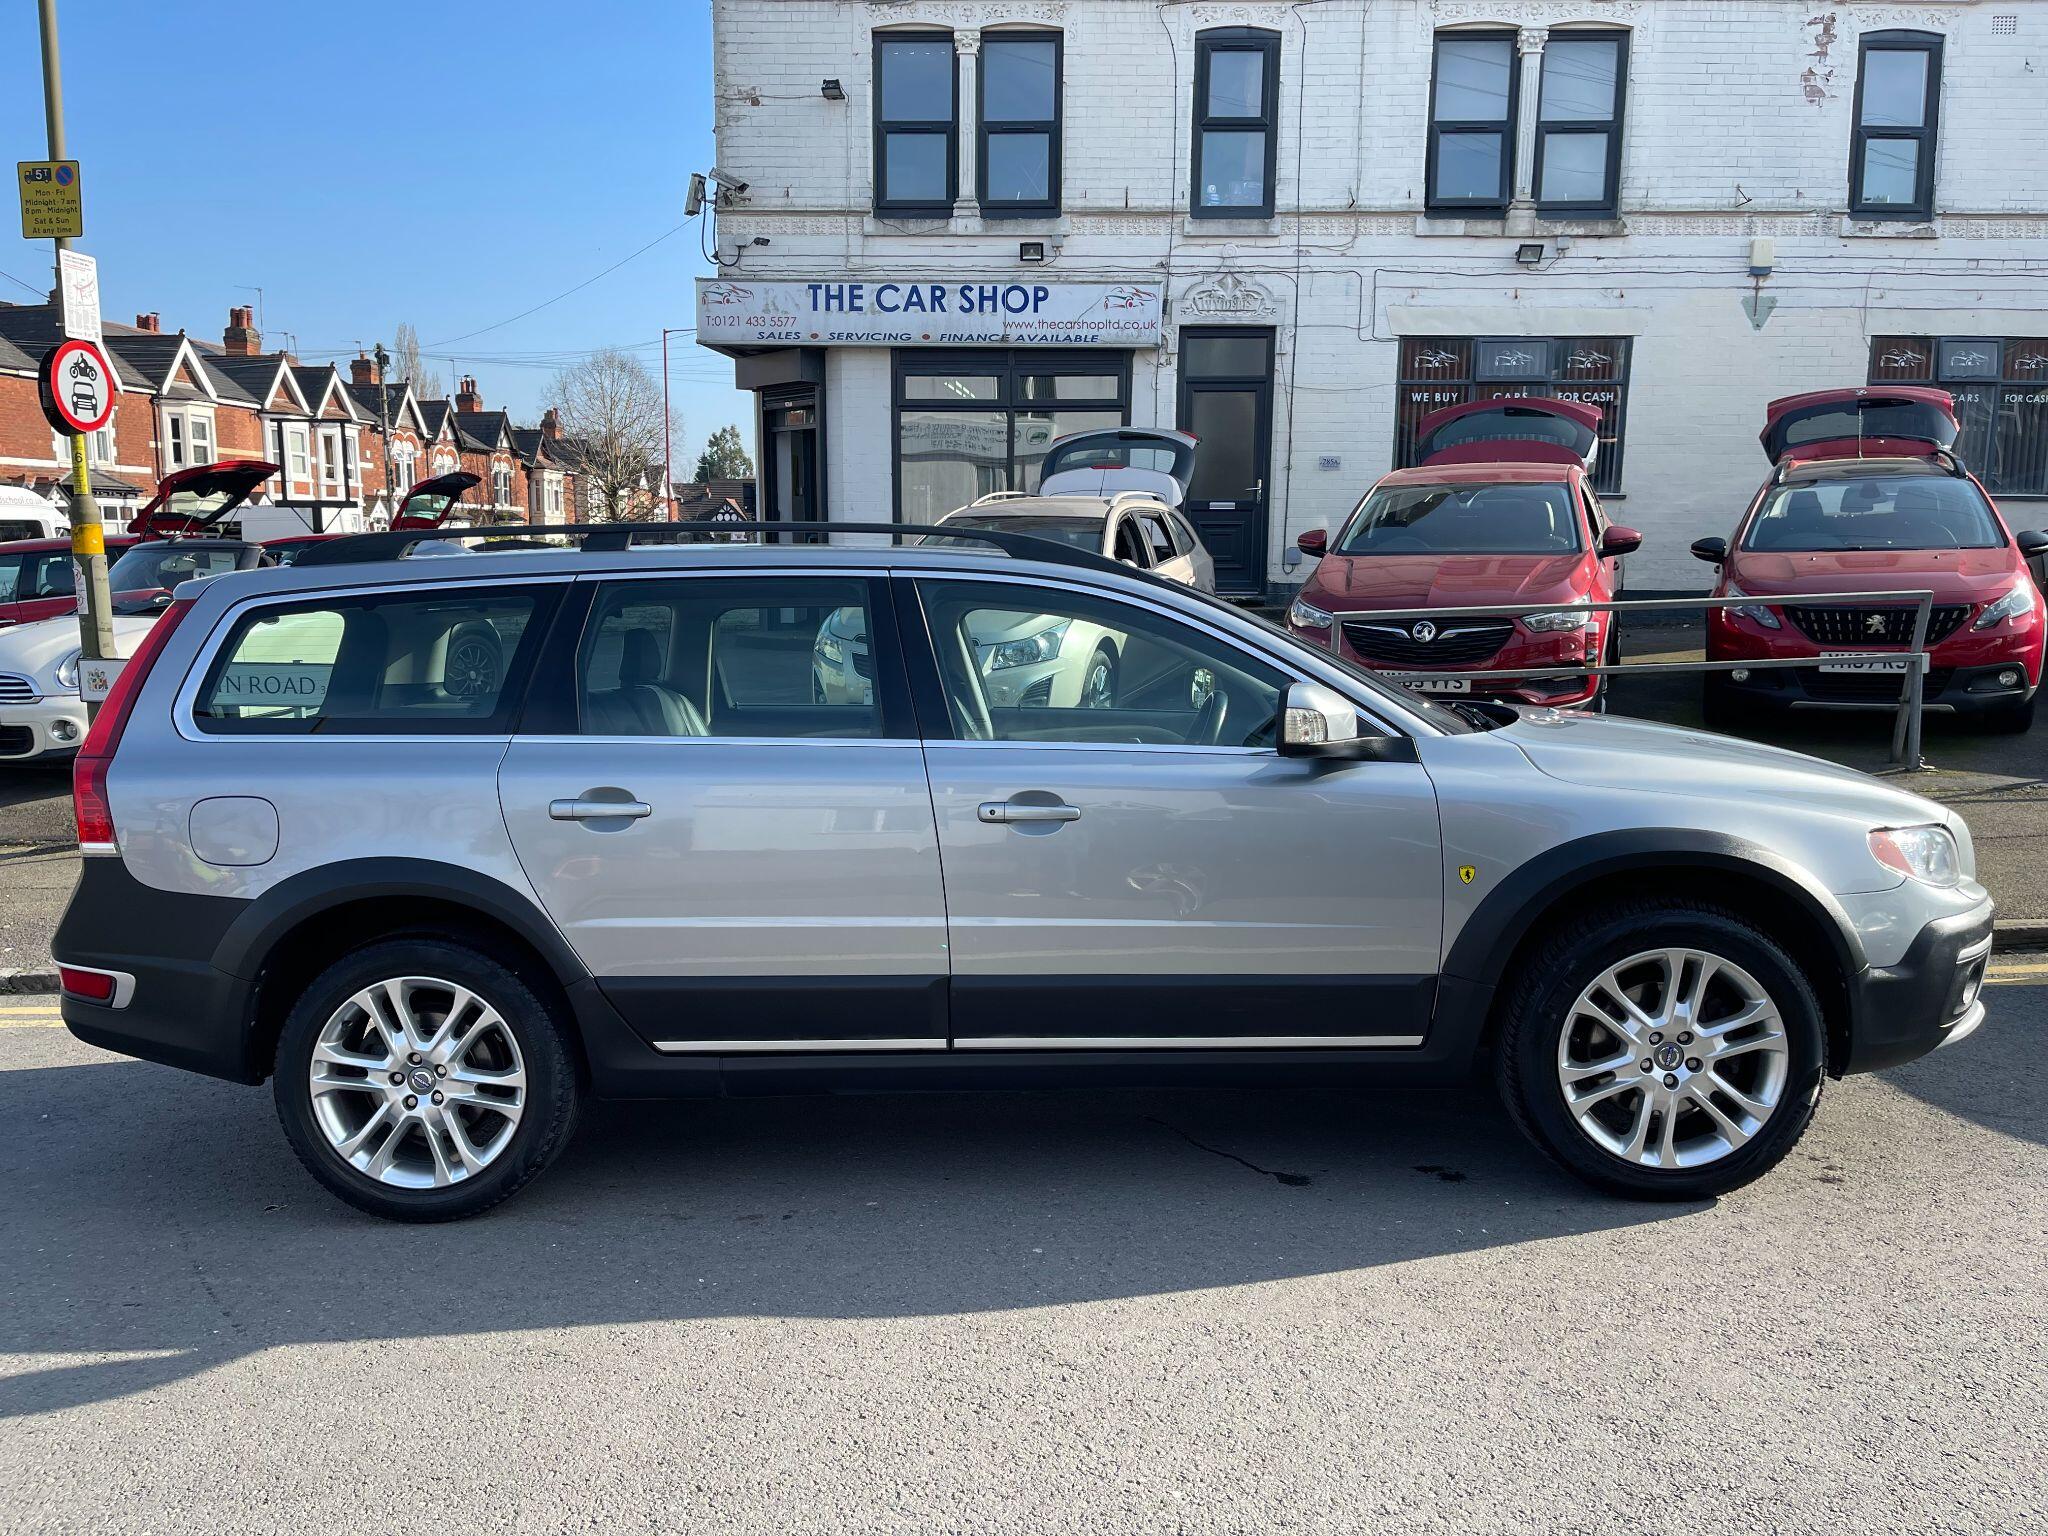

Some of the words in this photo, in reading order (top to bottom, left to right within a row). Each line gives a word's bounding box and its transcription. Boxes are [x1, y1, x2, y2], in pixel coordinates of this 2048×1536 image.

[25, 199, 56, 207] Midnight
[56, 226, 72, 234] time
[807, 284, 864, 311] THE
[875, 284, 947, 313] CAR
[958, 285, 1049, 314] SHOP
[745, 316, 766, 327] 433
[769, 317, 797, 327] 5577
[1002, 319, 1157, 333] www.thecarshopltd.co.uk
[757, 331, 801, 340] SALES
[828, 332, 912, 341] SERVICING
[939, 333, 1010, 342] FINANCE
[1014, 334, 1099, 343] AVAILABLE
[1411, 392, 1429, 402] WE
[1435, 392, 1458, 402] BUY
[1557, 392, 1579, 401] FOR
[1583, 392, 1614, 402] CASH
[1950, 393, 1980, 403] CARS
[2004, 394, 2024, 403] FOR
[75, 452, 83, 463] 6
[249, 675, 316, 695] ROAD
